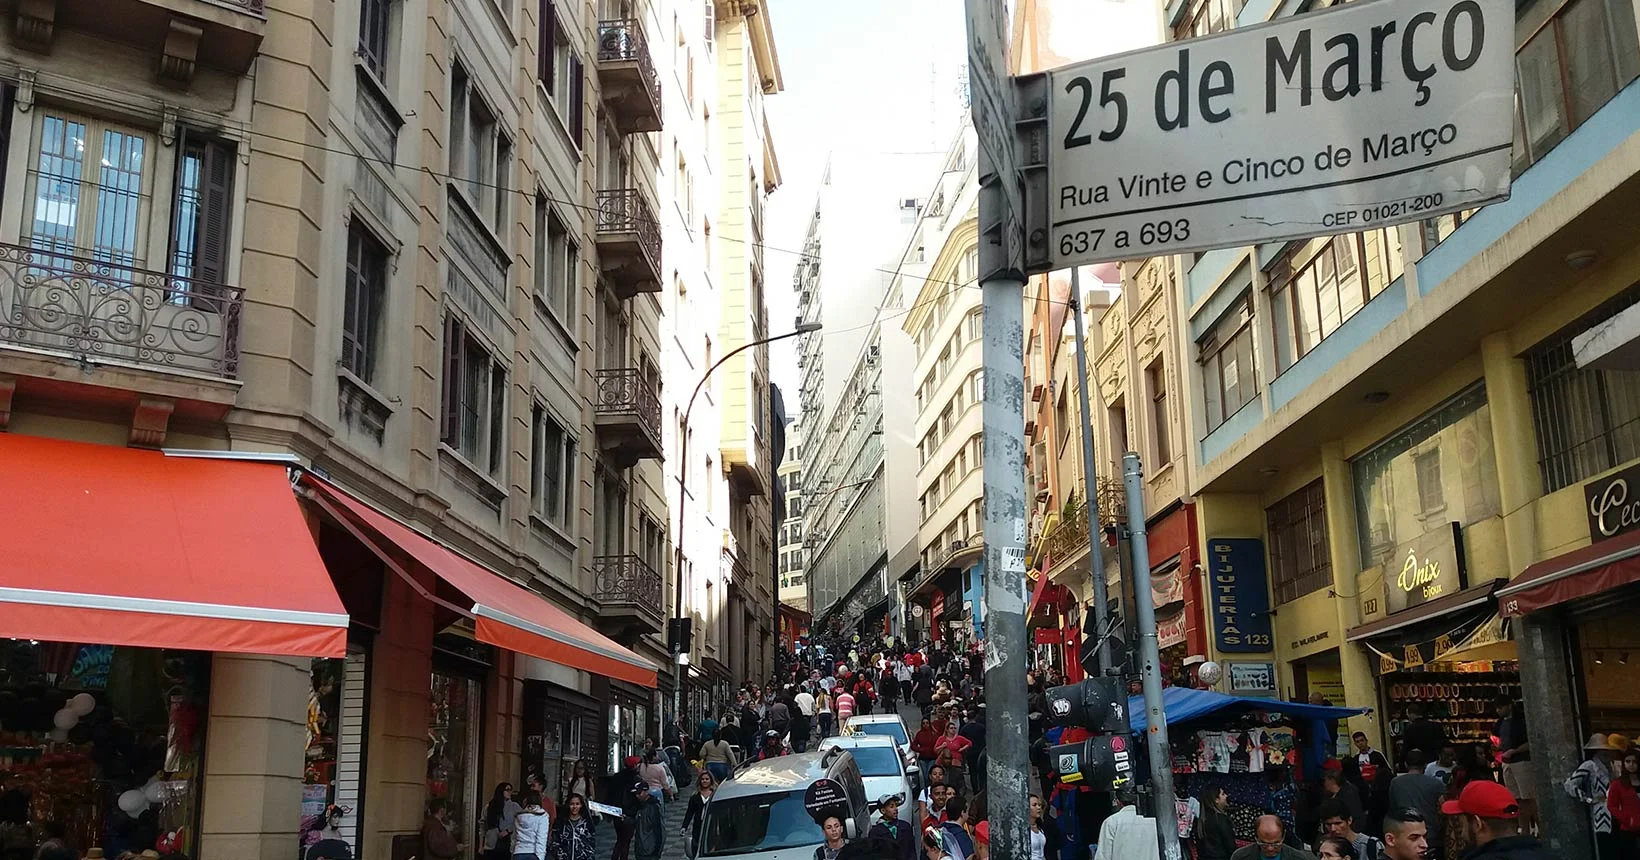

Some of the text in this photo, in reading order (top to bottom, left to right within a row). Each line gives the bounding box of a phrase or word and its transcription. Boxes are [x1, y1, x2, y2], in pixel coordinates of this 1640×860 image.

[1064, 67, 1128, 150] 25
[1155, 48, 1235, 132] de
[1265, 0, 1485, 114] Março
[1060, 123, 1458, 209] Rua Vinte e Cinco de Março
[1321, 192, 1444, 228] CEP 01021-200
[1060, 218, 1191, 256] 637 a 693
[1397, 547, 1441, 592] Ônix
[1214, 544, 1241, 645] BIJUTERIAS
[1364, 599, 1377, 615] 127
[1422, 583, 1443, 598] bijoux
[1244, 634, 1269, 645] 123
